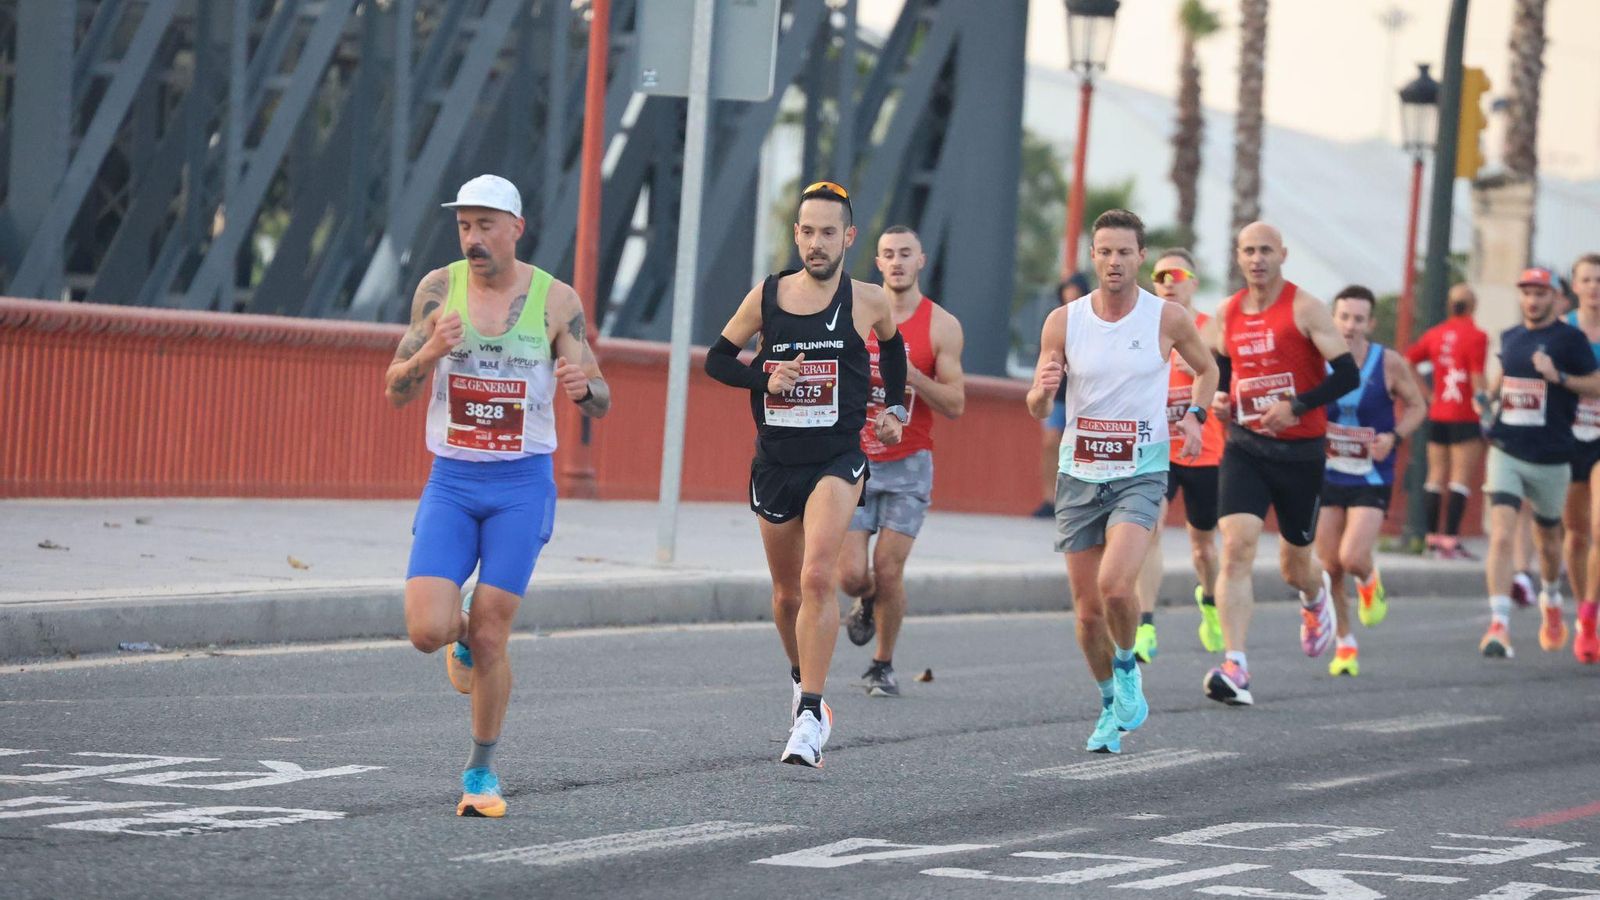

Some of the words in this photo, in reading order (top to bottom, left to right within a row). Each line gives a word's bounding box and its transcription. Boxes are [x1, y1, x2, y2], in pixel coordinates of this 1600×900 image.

[799, 363, 832, 374] NERALI
[467, 379, 521, 394] GENERALI
[782, 385, 822, 398] 17675
[465, 402, 504, 419] 3828
[1088, 421, 1132, 432] GENERALI
[1085, 440, 1122, 453] 14783
